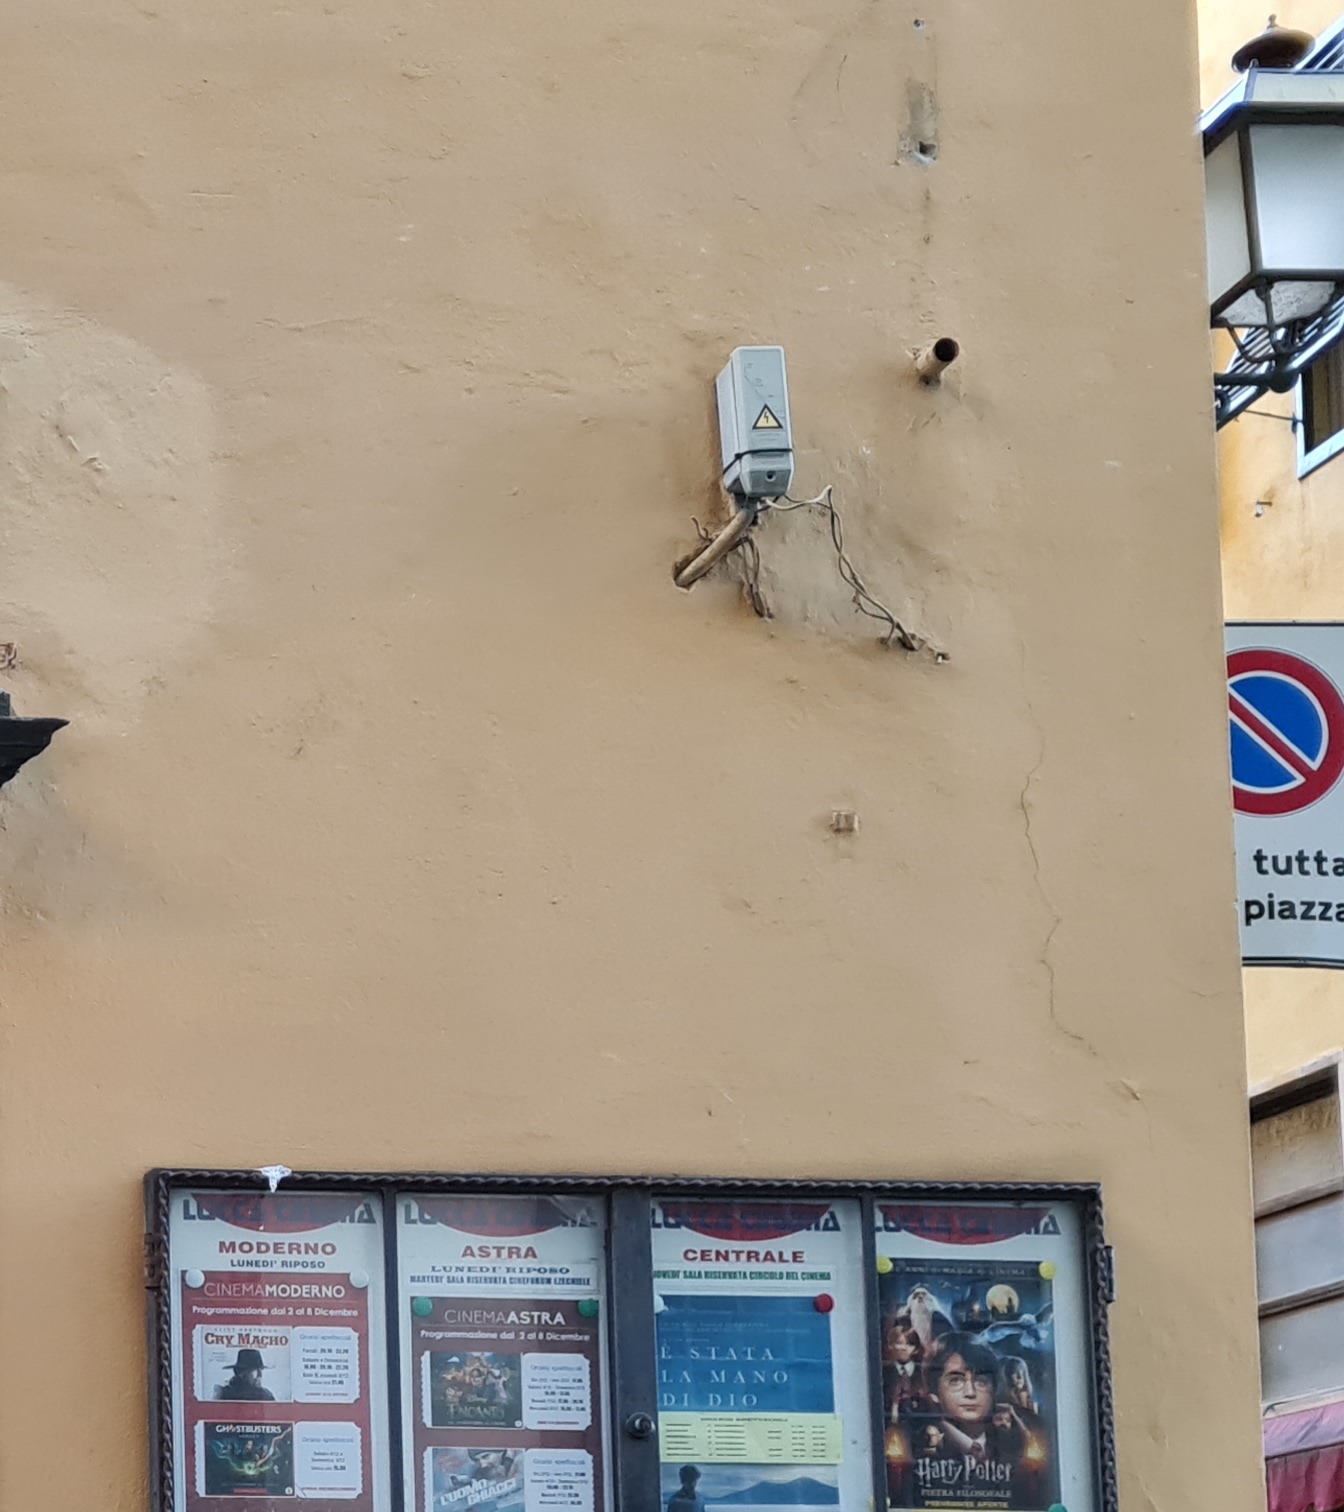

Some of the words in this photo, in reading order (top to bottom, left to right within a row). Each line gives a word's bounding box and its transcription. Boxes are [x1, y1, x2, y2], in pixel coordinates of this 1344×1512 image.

[1253, 848, 1344, 877] tutta
[1244, 893, 1344, 926] piazza
[218, 1241, 337, 1256] MODERNO
[461, 1245, 538, 1259] ASTRA
[683, 1249, 805, 1263] CENTRALE
[230, 1259, 277, 1268] LUNEDI'
[281, 1260, 326, 1269] RIPOSO
[504, 1266, 570, 1274] RIPOSO
[466, 1276, 507, 1285] RISERVATA
[683, 1270, 702, 1279] SALA
[704, 1271, 747, 1280] RISERVATA
[192, 1305, 269, 1316] Programmazione
[271, 1307, 286, 1316] dal
[287, 1308, 294, 1316] 2
[295, 1307, 306, 1316] al
[314, 1307, 359, 1317] Dicembre
[204, 1333, 236, 1345] CRY
[237, 1332, 289, 1346] MACHO
[420, 1329, 498, 1340] Programmazione
[499, 1331, 515, 1340] dal
[545, 1331, 590, 1341] Dicembre
[690, 1346, 775, 1360] STATA
[662, 1370, 692, 1384] LA
[710, 1370, 788, 1384] MANO
[663, 1393, 688, 1407] DI
[709, 1393, 758, 1407] DIO
[914, 1457, 962, 1487] Harry
[963, 1455, 1012, 1482] Potter
[467, 1477, 517, 1506] GHIACCI
